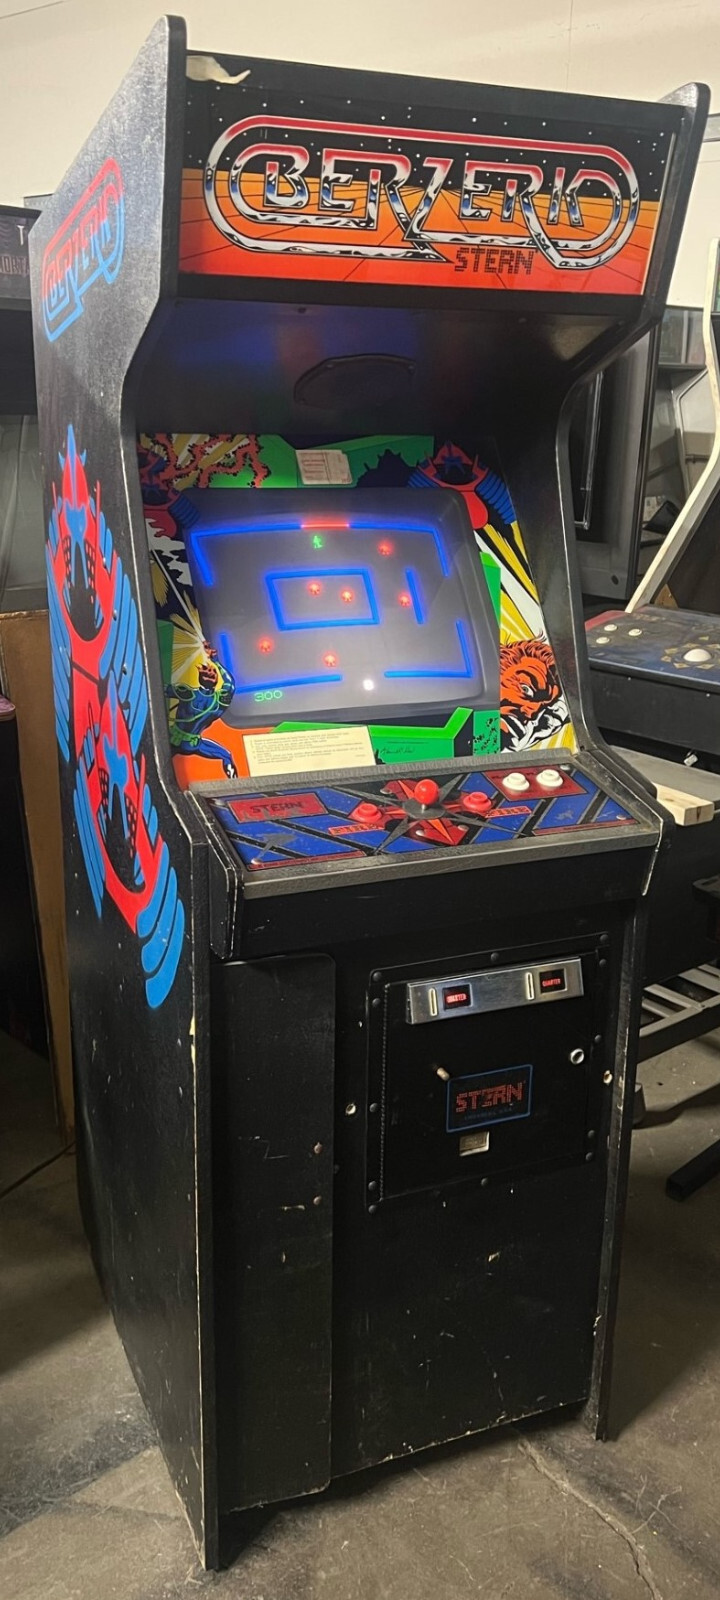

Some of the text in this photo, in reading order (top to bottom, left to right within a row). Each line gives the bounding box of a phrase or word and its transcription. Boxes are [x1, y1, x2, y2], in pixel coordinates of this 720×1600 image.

[203, 115, 640, 270] BERZERK
[454, 247, 535, 275] STERN
[254, 689, 283, 702] 300
